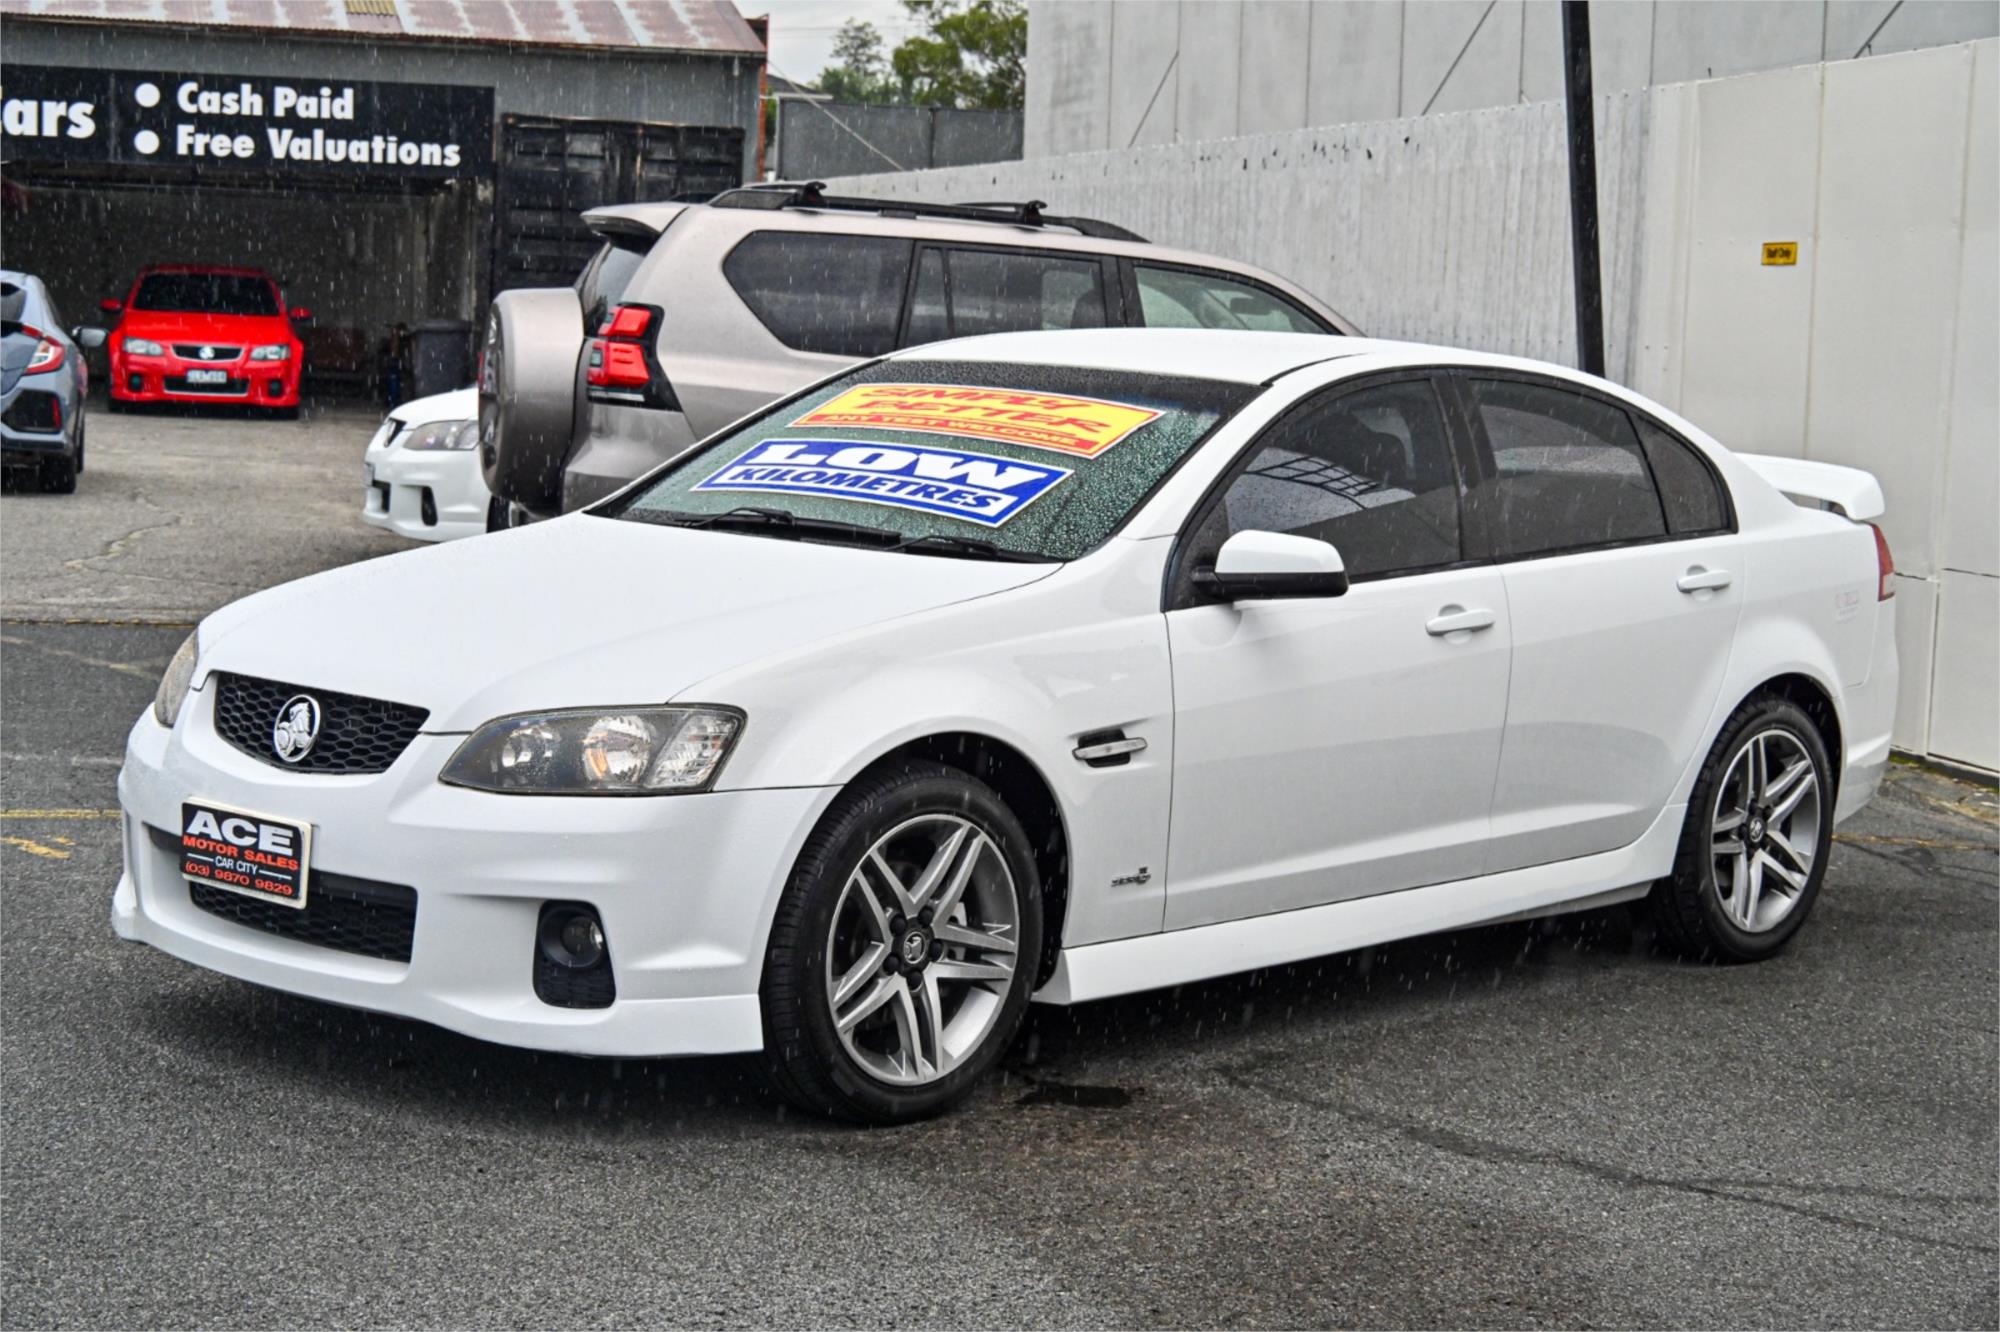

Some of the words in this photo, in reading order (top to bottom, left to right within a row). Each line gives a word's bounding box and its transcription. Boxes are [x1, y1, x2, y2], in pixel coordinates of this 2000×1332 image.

[0, 94, 96, 139] ars
[177, 81, 263, 116] Cash
[273, 86, 354, 120] Paid
[176, 124, 255, 158] Free
[267, 128, 461, 167] Valuations
[854, 400, 1111, 433] BETTER
[861, 387, 1092, 410] SIMPLY
[823, 414, 875, 422] ANY
[882, 416, 943, 426] TEST
[948, 421, 1080, 447] WELCOME
[745, 444, 1049, 491] LOW
[728, 468, 1003, 508] KILOMETRES
[186, 809, 294, 857] ACE
[182, 835, 239, 858] MOTOR
[244, 849, 299, 871] SALES
[215, 855, 234, 870] CAR
[236, 861, 258, 875] CITY
[185, 861, 211, 877] (03)
[214, 869, 250, 886] 9870
[255, 878, 293, 896] 9829
